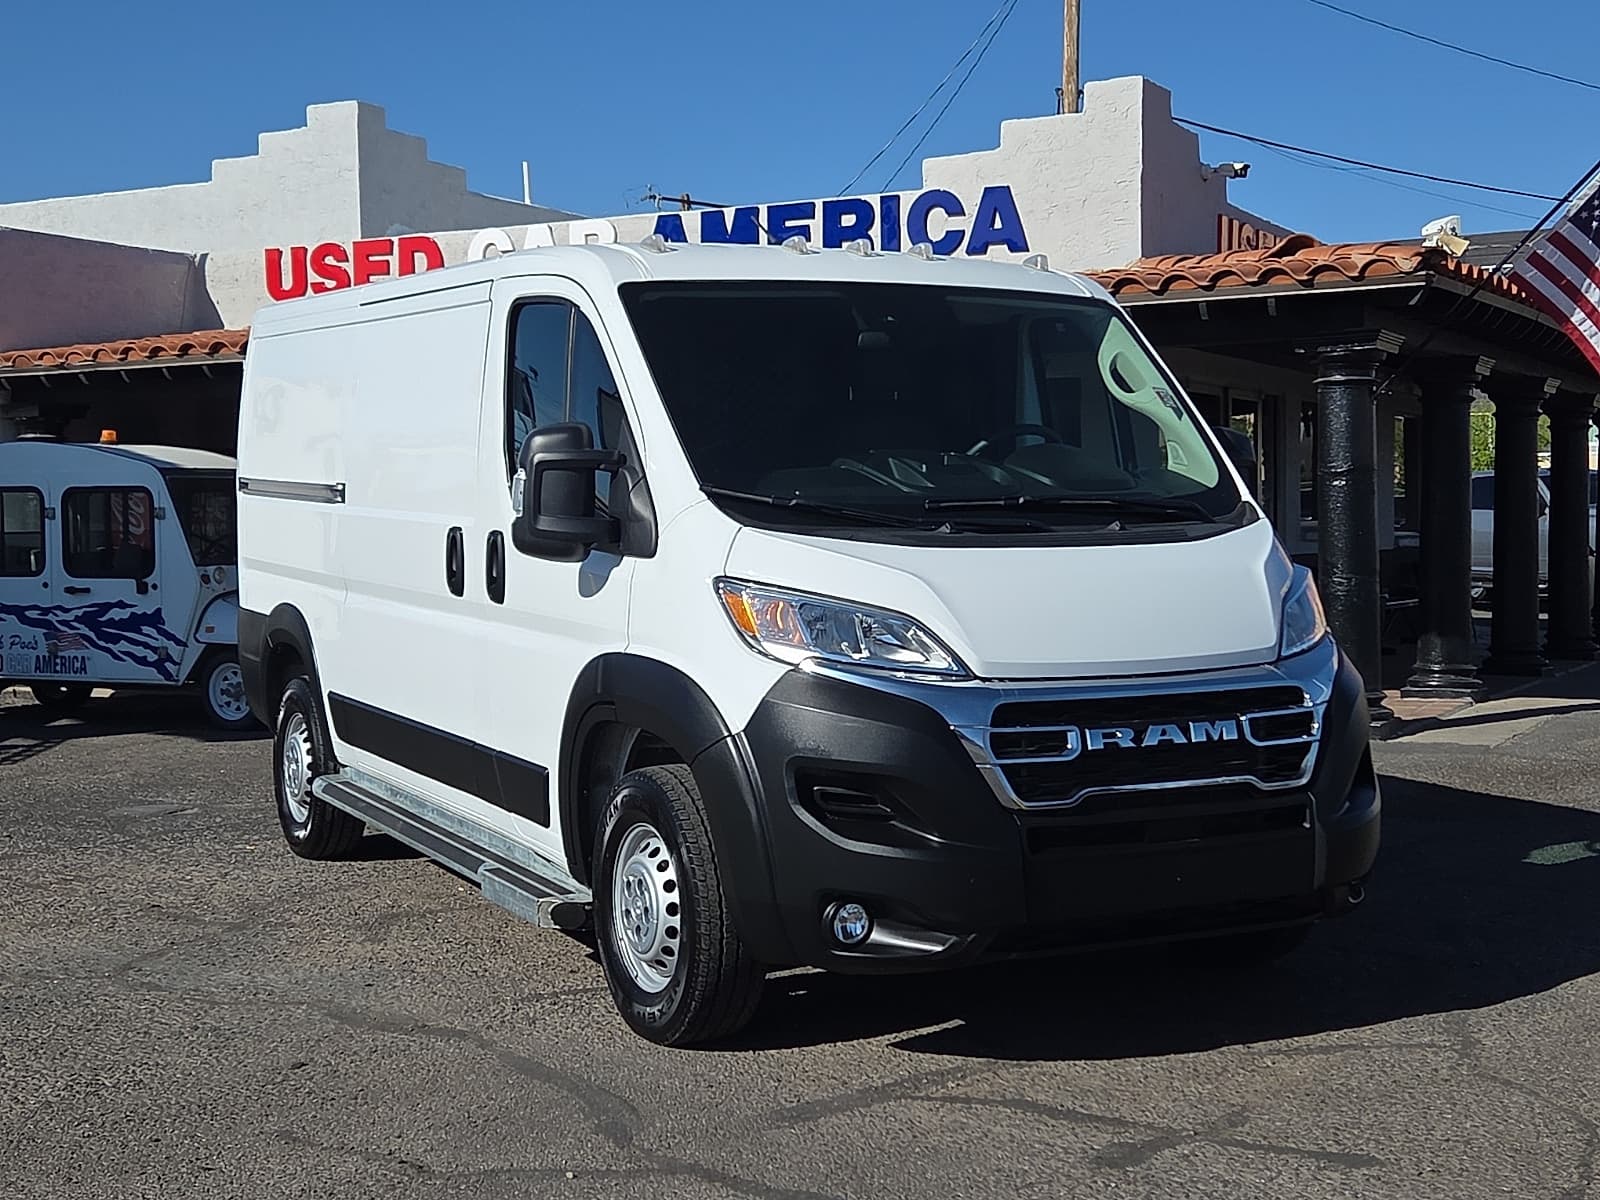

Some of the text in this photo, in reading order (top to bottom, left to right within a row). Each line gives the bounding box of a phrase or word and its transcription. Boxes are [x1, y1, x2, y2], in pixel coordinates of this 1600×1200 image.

[265, 236, 445, 301] USED
[34, 654, 87, 675] AMERICA
[1085, 719, 1238, 750] RAM
